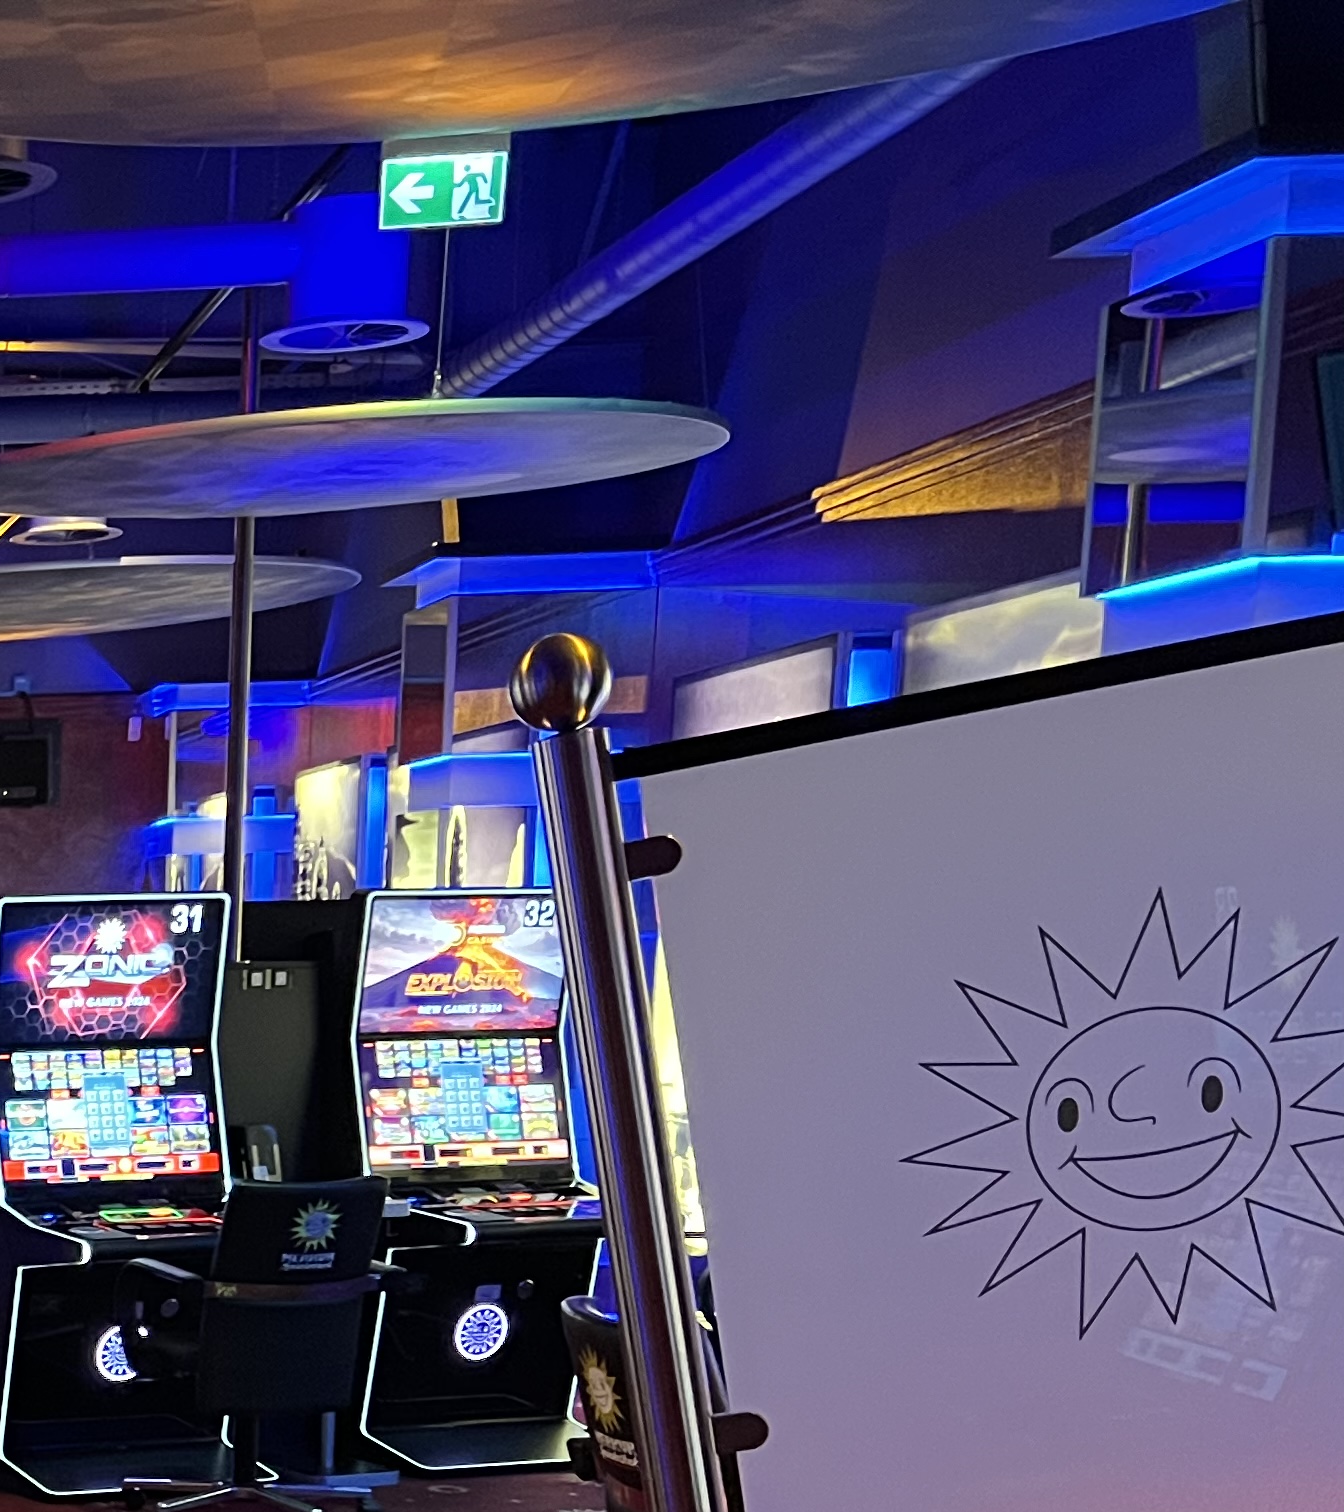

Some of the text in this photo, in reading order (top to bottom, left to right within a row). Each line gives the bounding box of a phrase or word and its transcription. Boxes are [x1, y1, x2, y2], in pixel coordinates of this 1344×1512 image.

[170, 903, 204, 934] 31
[524, 900, 556, 927] 32
[404, 971, 523, 993] EXPLOSION
